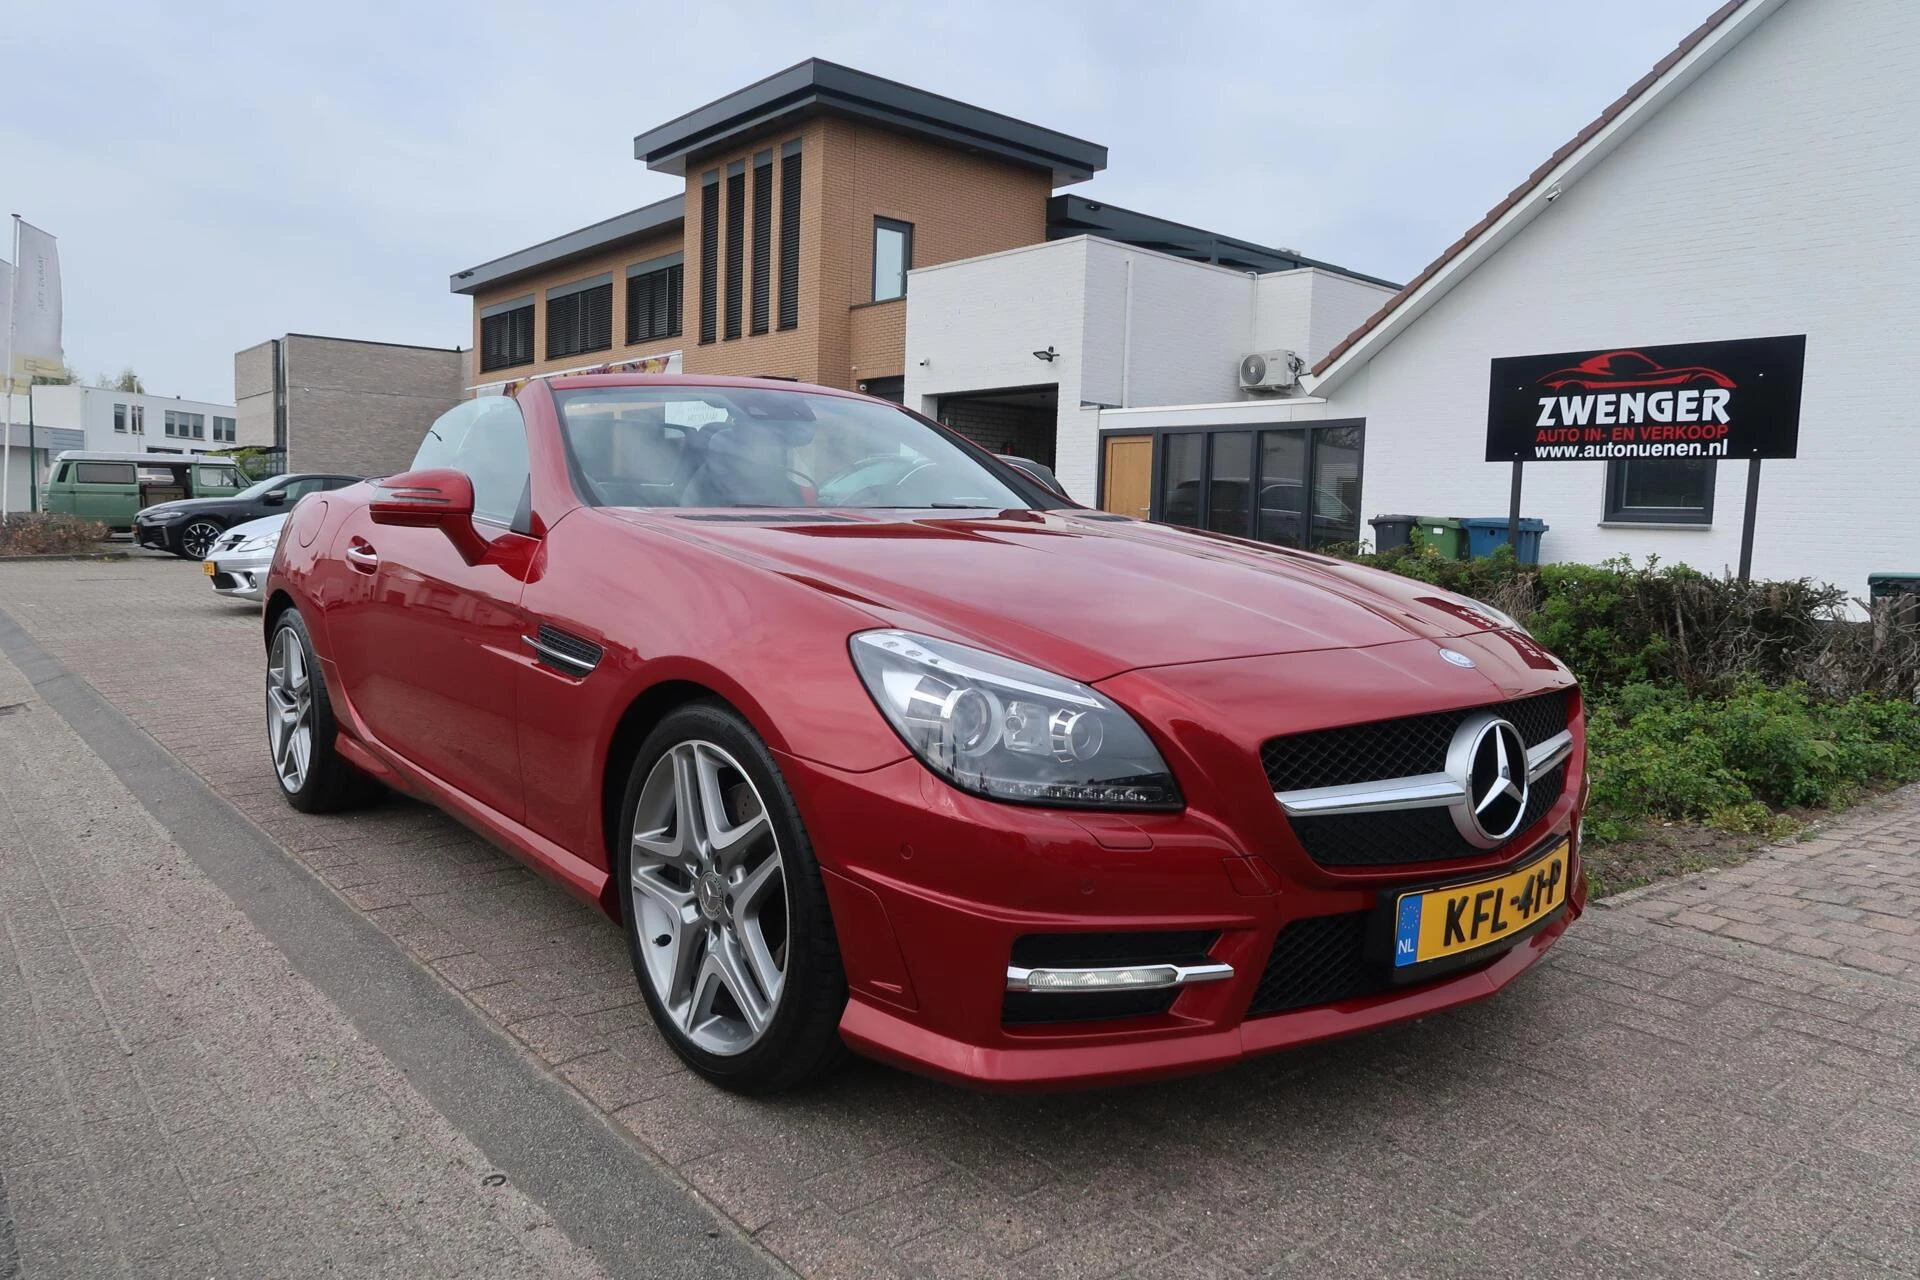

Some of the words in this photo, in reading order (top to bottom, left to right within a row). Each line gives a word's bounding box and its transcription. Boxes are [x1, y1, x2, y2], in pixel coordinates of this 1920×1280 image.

[1536, 389, 1731, 427] ZWENGER
[1536, 428, 1580, 443] AUTO
[1584, 427, 1607, 441] IN-
[1612, 426, 1635, 441] EN
[1639, 424, 1729, 441] VERKOOP
[1535, 439, 1728, 458] www.autonuenen.nl
[1398, 938, 1414, 954] NL
